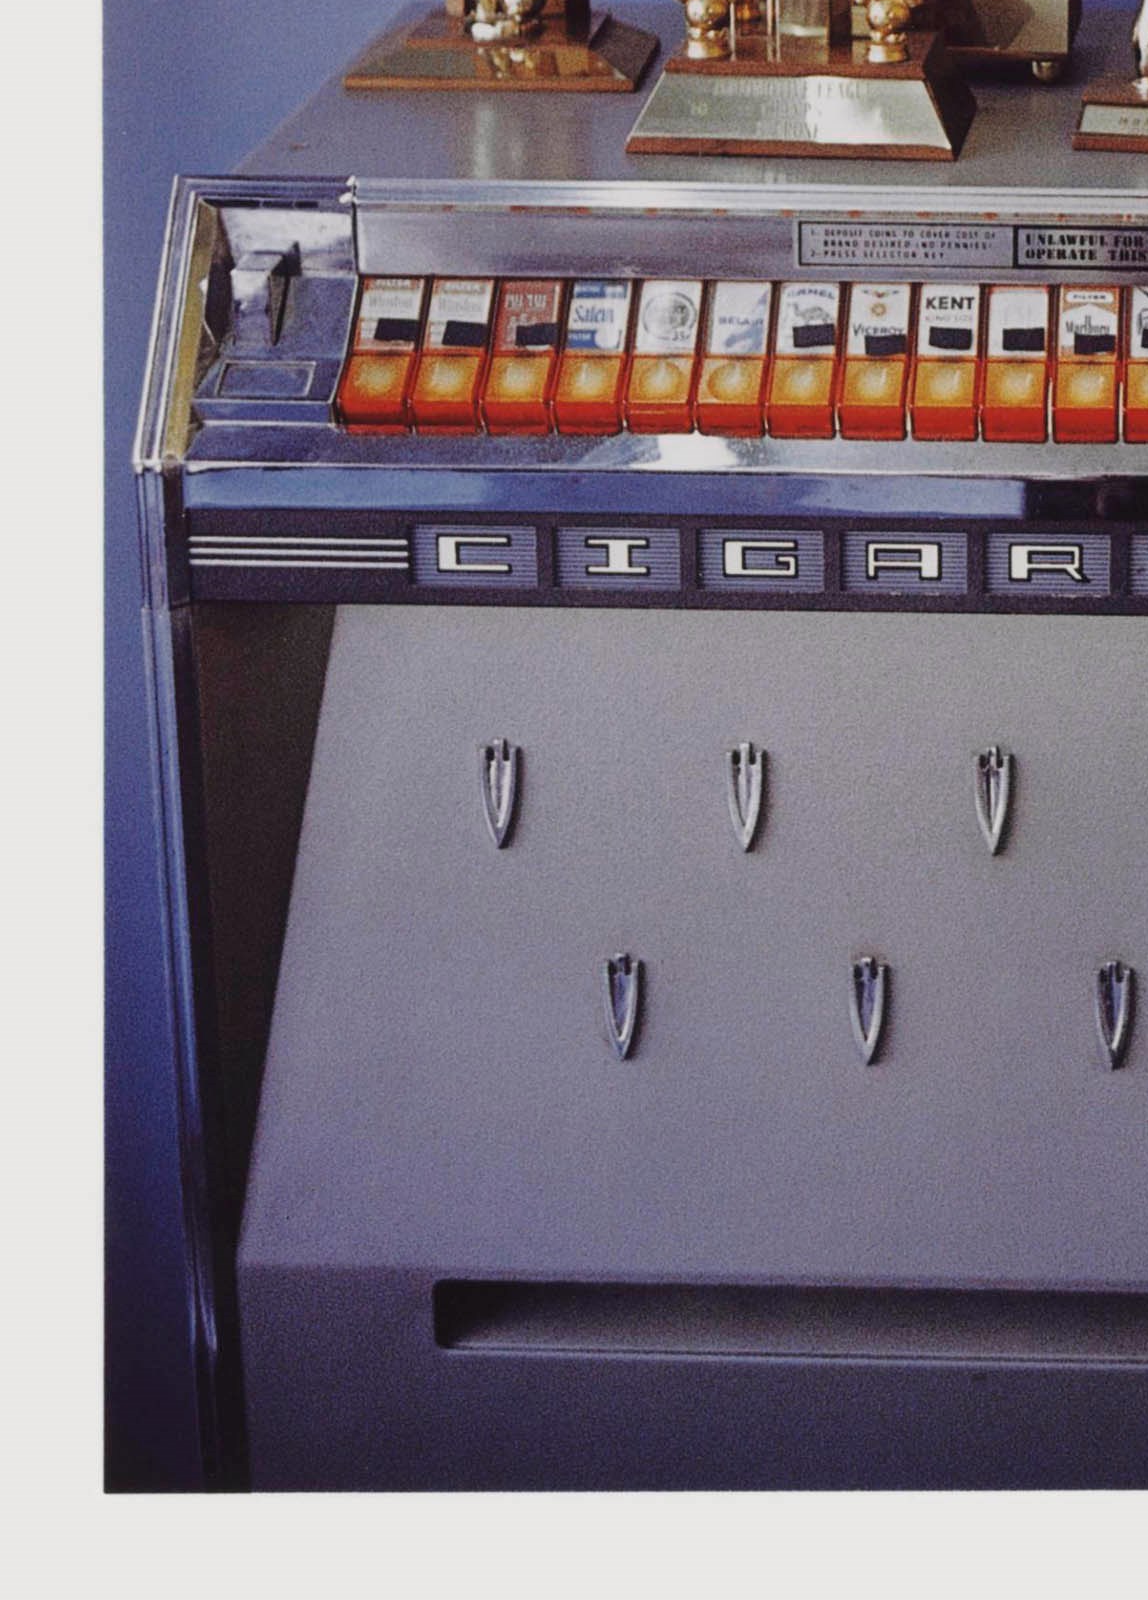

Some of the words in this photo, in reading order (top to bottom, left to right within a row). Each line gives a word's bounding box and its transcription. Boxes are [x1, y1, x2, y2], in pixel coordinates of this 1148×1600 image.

[824, 229, 863, 238] DEPOSIT
[869, 230, 897, 238] COINS
[903, 230, 914, 238] TO
[823, 240, 858, 248] BRAND
[1025, 233, 1106, 246] UNLAWFUL
[1114, 235, 1143, 248] FOR
[1025, 248, 1097, 260] OPERATE
[1108, 249, 1146, 261] THIS
[787, 288, 836, 300] CAMEL
[926, 296, 975, 310] KENT
[573, 304, 615, 324] Salem
